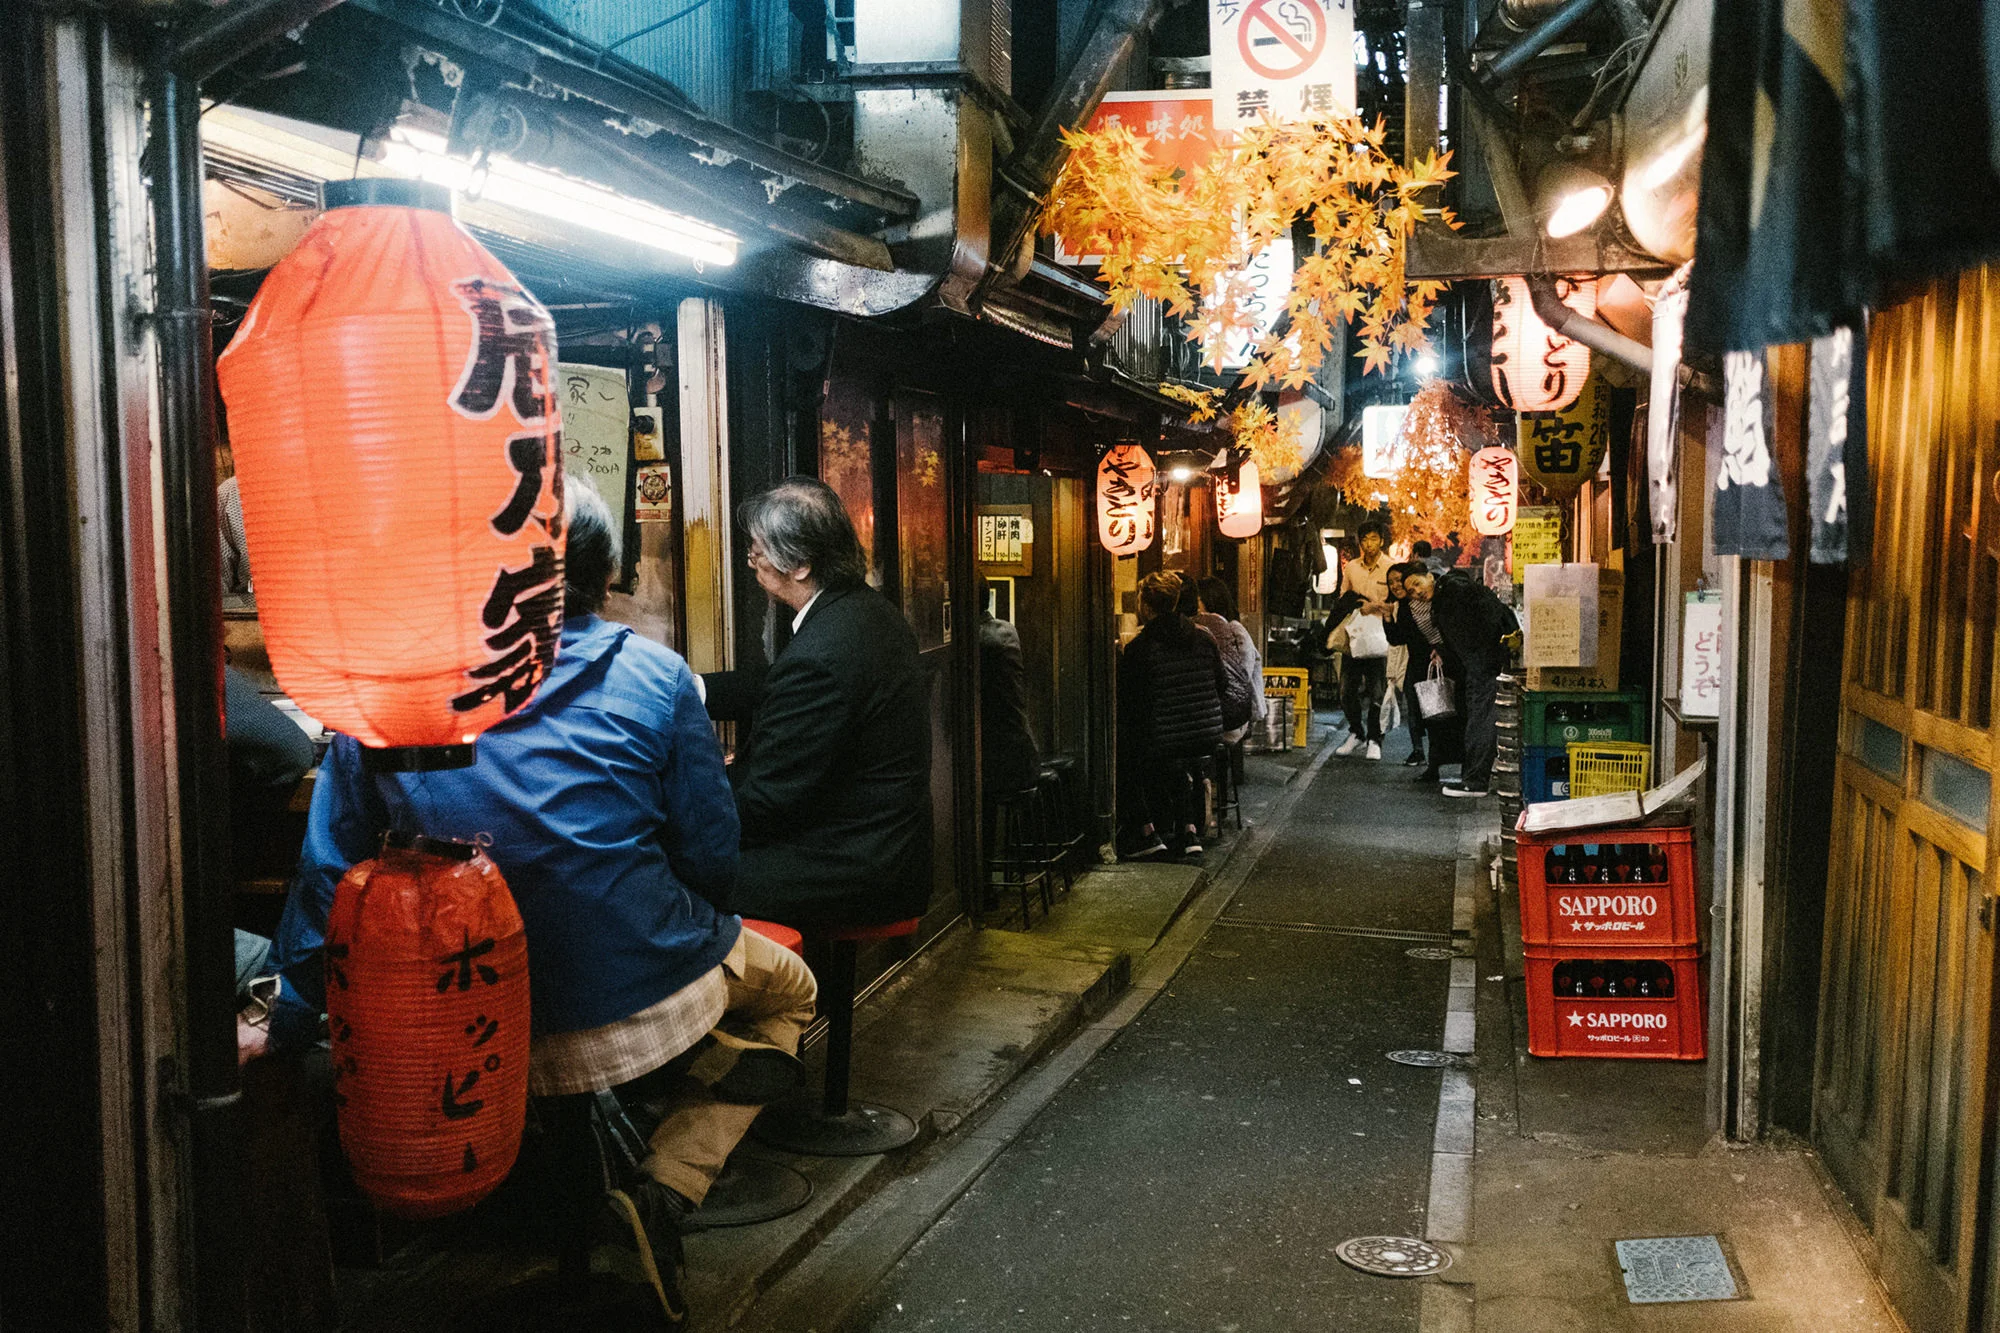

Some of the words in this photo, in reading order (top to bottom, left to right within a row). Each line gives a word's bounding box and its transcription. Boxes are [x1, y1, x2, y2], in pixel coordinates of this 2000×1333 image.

[1236, 83, 1333, 118] 禁煙
[1102, 453, 1140, 548] やきとり
[1480, 456, 1513, 528] やきとり
[997, 520, 1007, 540] 砂肝
[1691, 631, 1716, 698] どうぞ
[1559, 895, 1657, 916] SAPPORO
[1583, 921, 1646, 931] サッポロビール
[1587, 1012, 1667, 1028] SAPPORO
[436, 925, 500, 1173] ホッピー
[1587, 1034, 1631, 1042] サッポロビール
